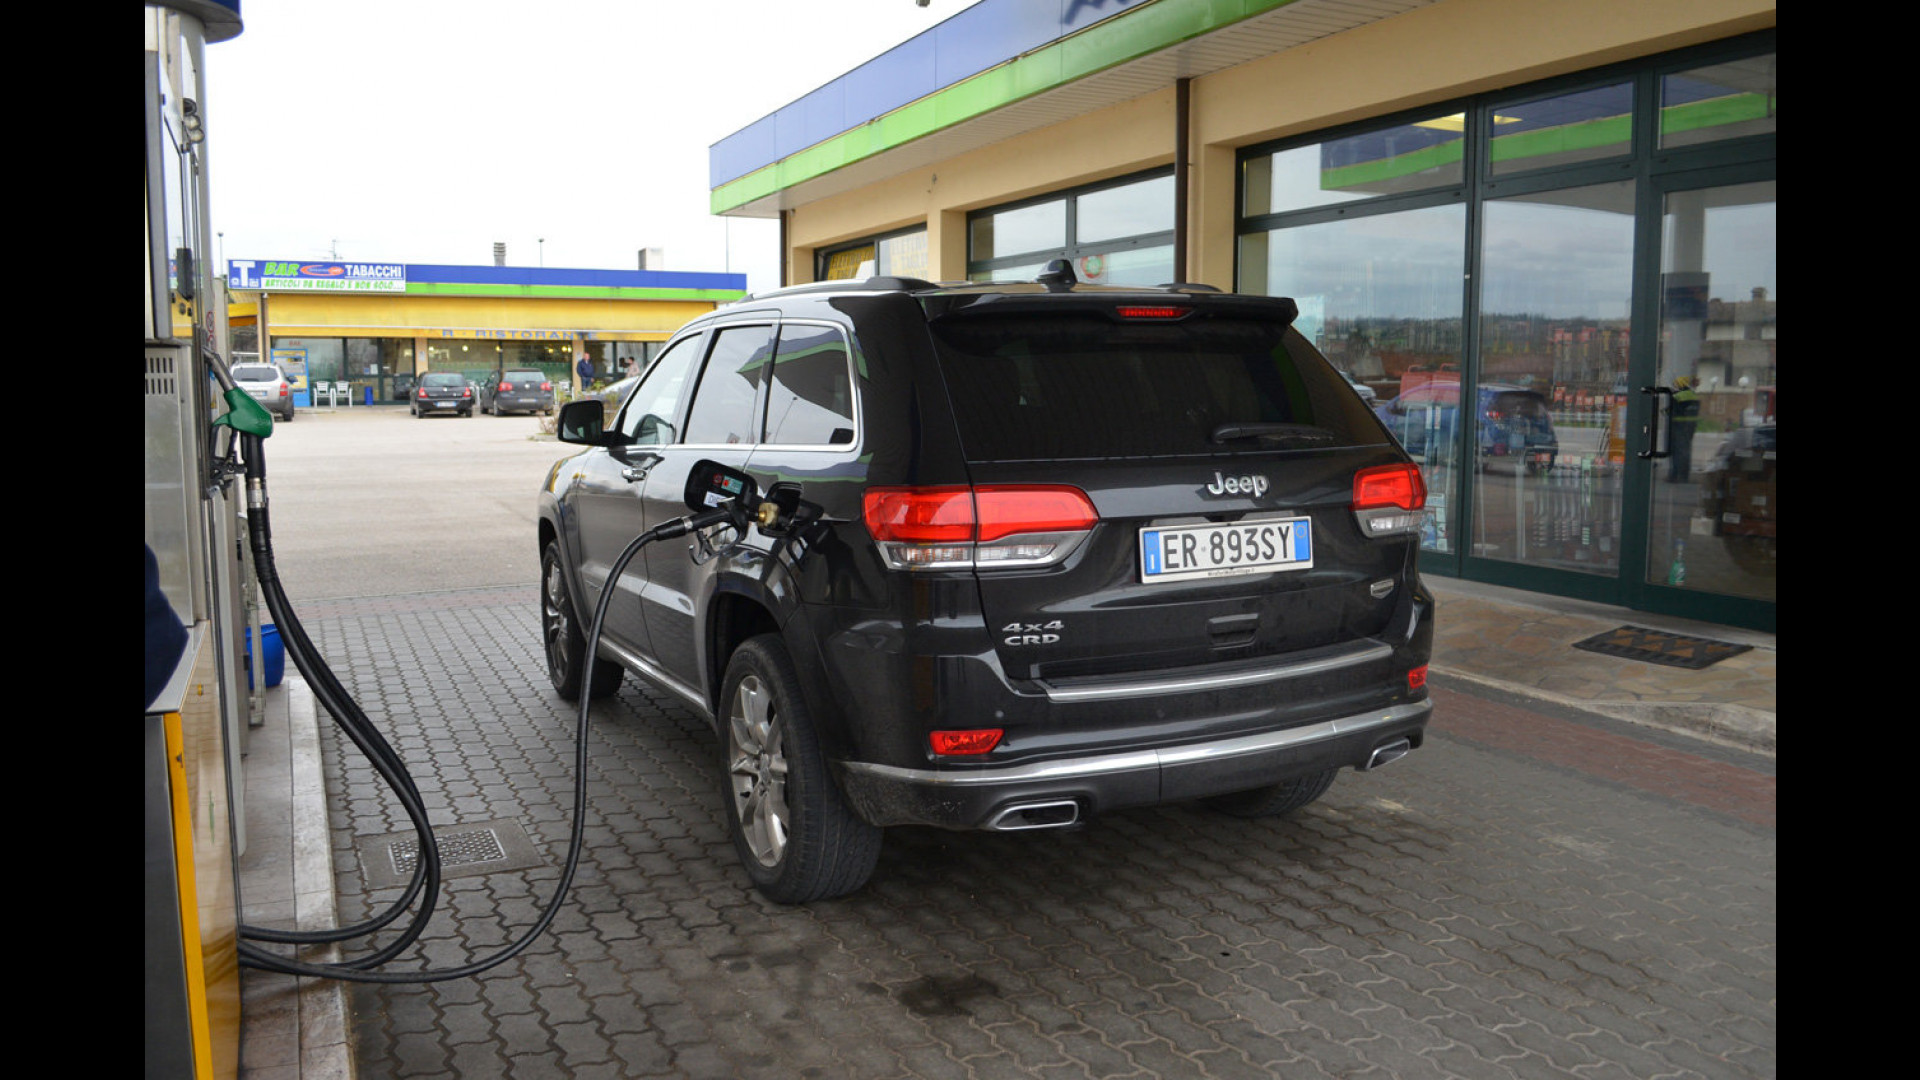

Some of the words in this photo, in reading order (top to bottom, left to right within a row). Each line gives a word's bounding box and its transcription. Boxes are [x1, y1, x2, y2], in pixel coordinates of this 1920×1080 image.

[263, 262, 300, 276] BAR
[345, 265, 401, 277] TABACCHI
[265, 279, 299, 288] ARTICOLI
[302, 280, 313, 288] DA
[316, 280, 345, 289] REGALO
[354, 281, 371, 289] NON
[475, 330, 598, 340] RISTORANTE
[1207, 472, 1269, 498] Jeep
[1163, 533, 1198, 569] ER
[1209, 525, 1290, 565] 893SY
[1002, 620, 1064, 632] 4x4
[1004, 633, 1060, 646] CRD
